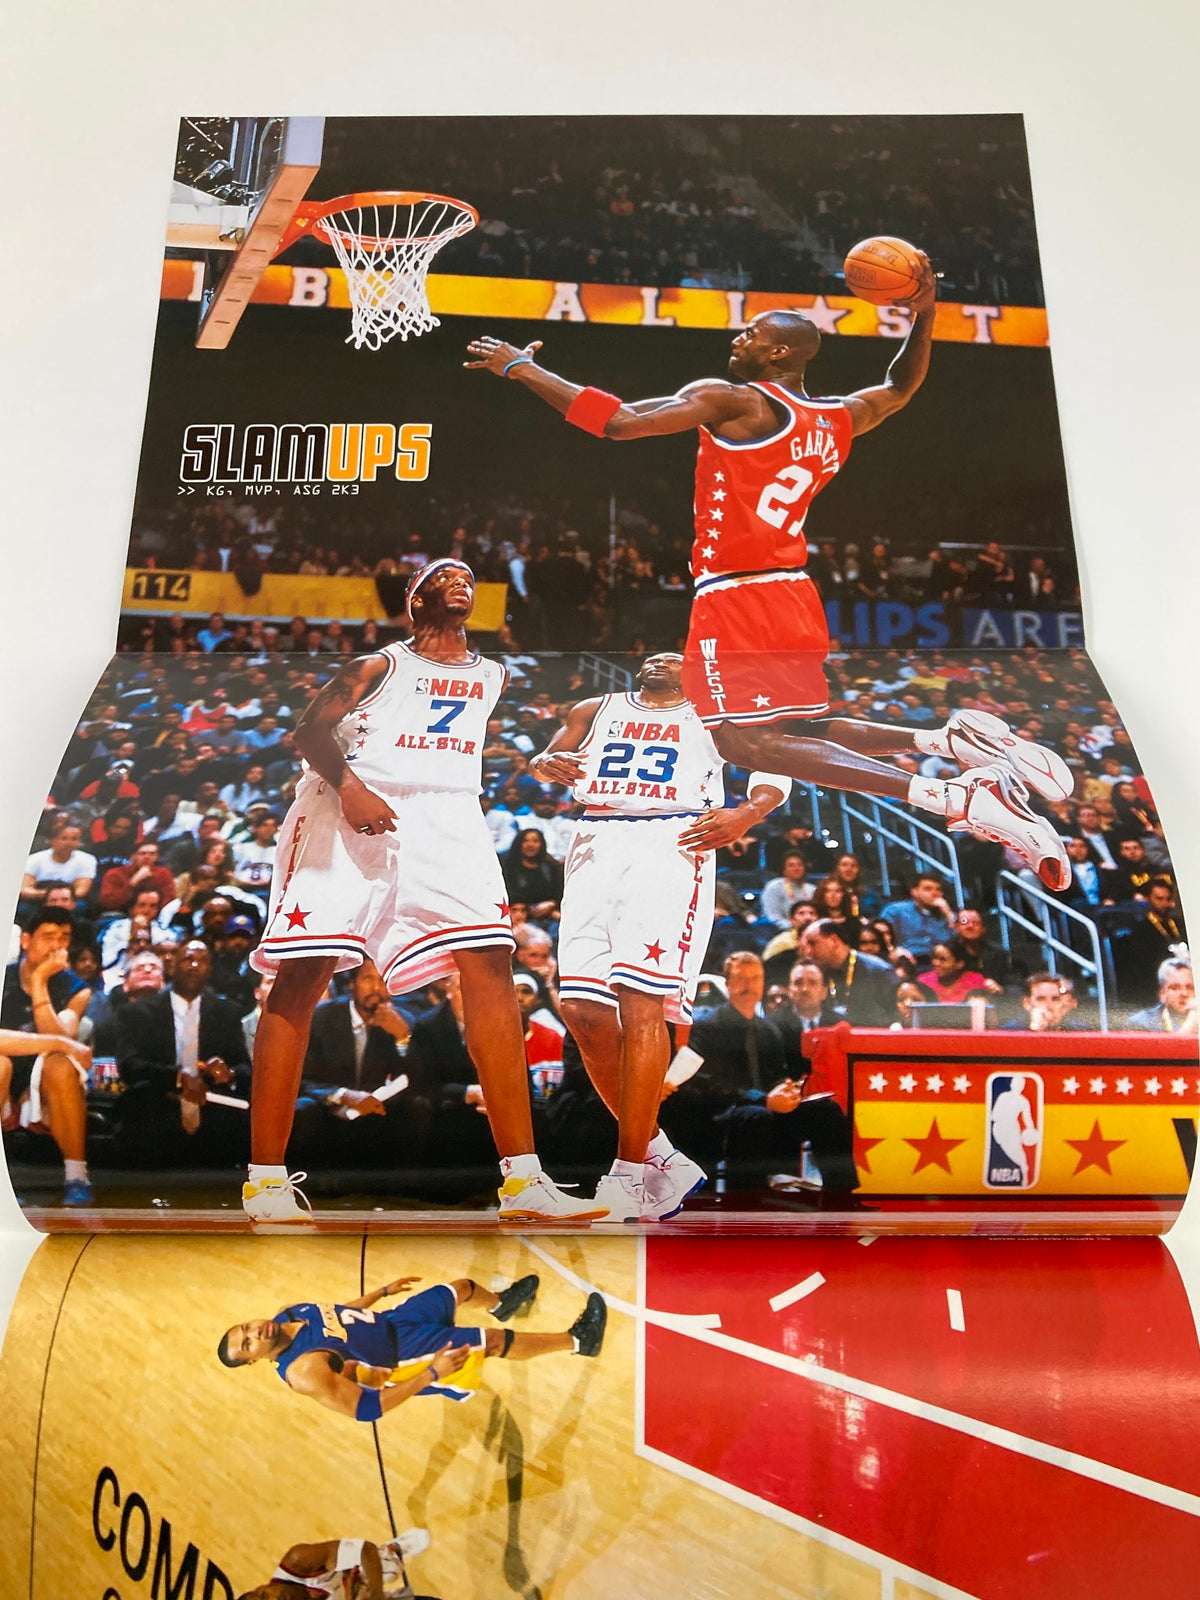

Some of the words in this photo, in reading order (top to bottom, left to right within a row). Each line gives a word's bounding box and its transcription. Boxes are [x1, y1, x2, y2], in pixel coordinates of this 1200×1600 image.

[179, 423, 433, 482] SLAMUPS
[293, 485, 321, 495] ASG
[332, 484, 360, 495] 2K3
[135, 575, 187, 598] 114
[699, 638, 727, 713] WEST
[429, 678, 484, 700] NBA
[426, 699, 468, 734] 7
[622, 721, 681, 742] NBA
[597, 742, 679, 784] 23
[587, 780, 678, 801] ALL-STAR
[990, 1167, 1021, 1183] NBA
